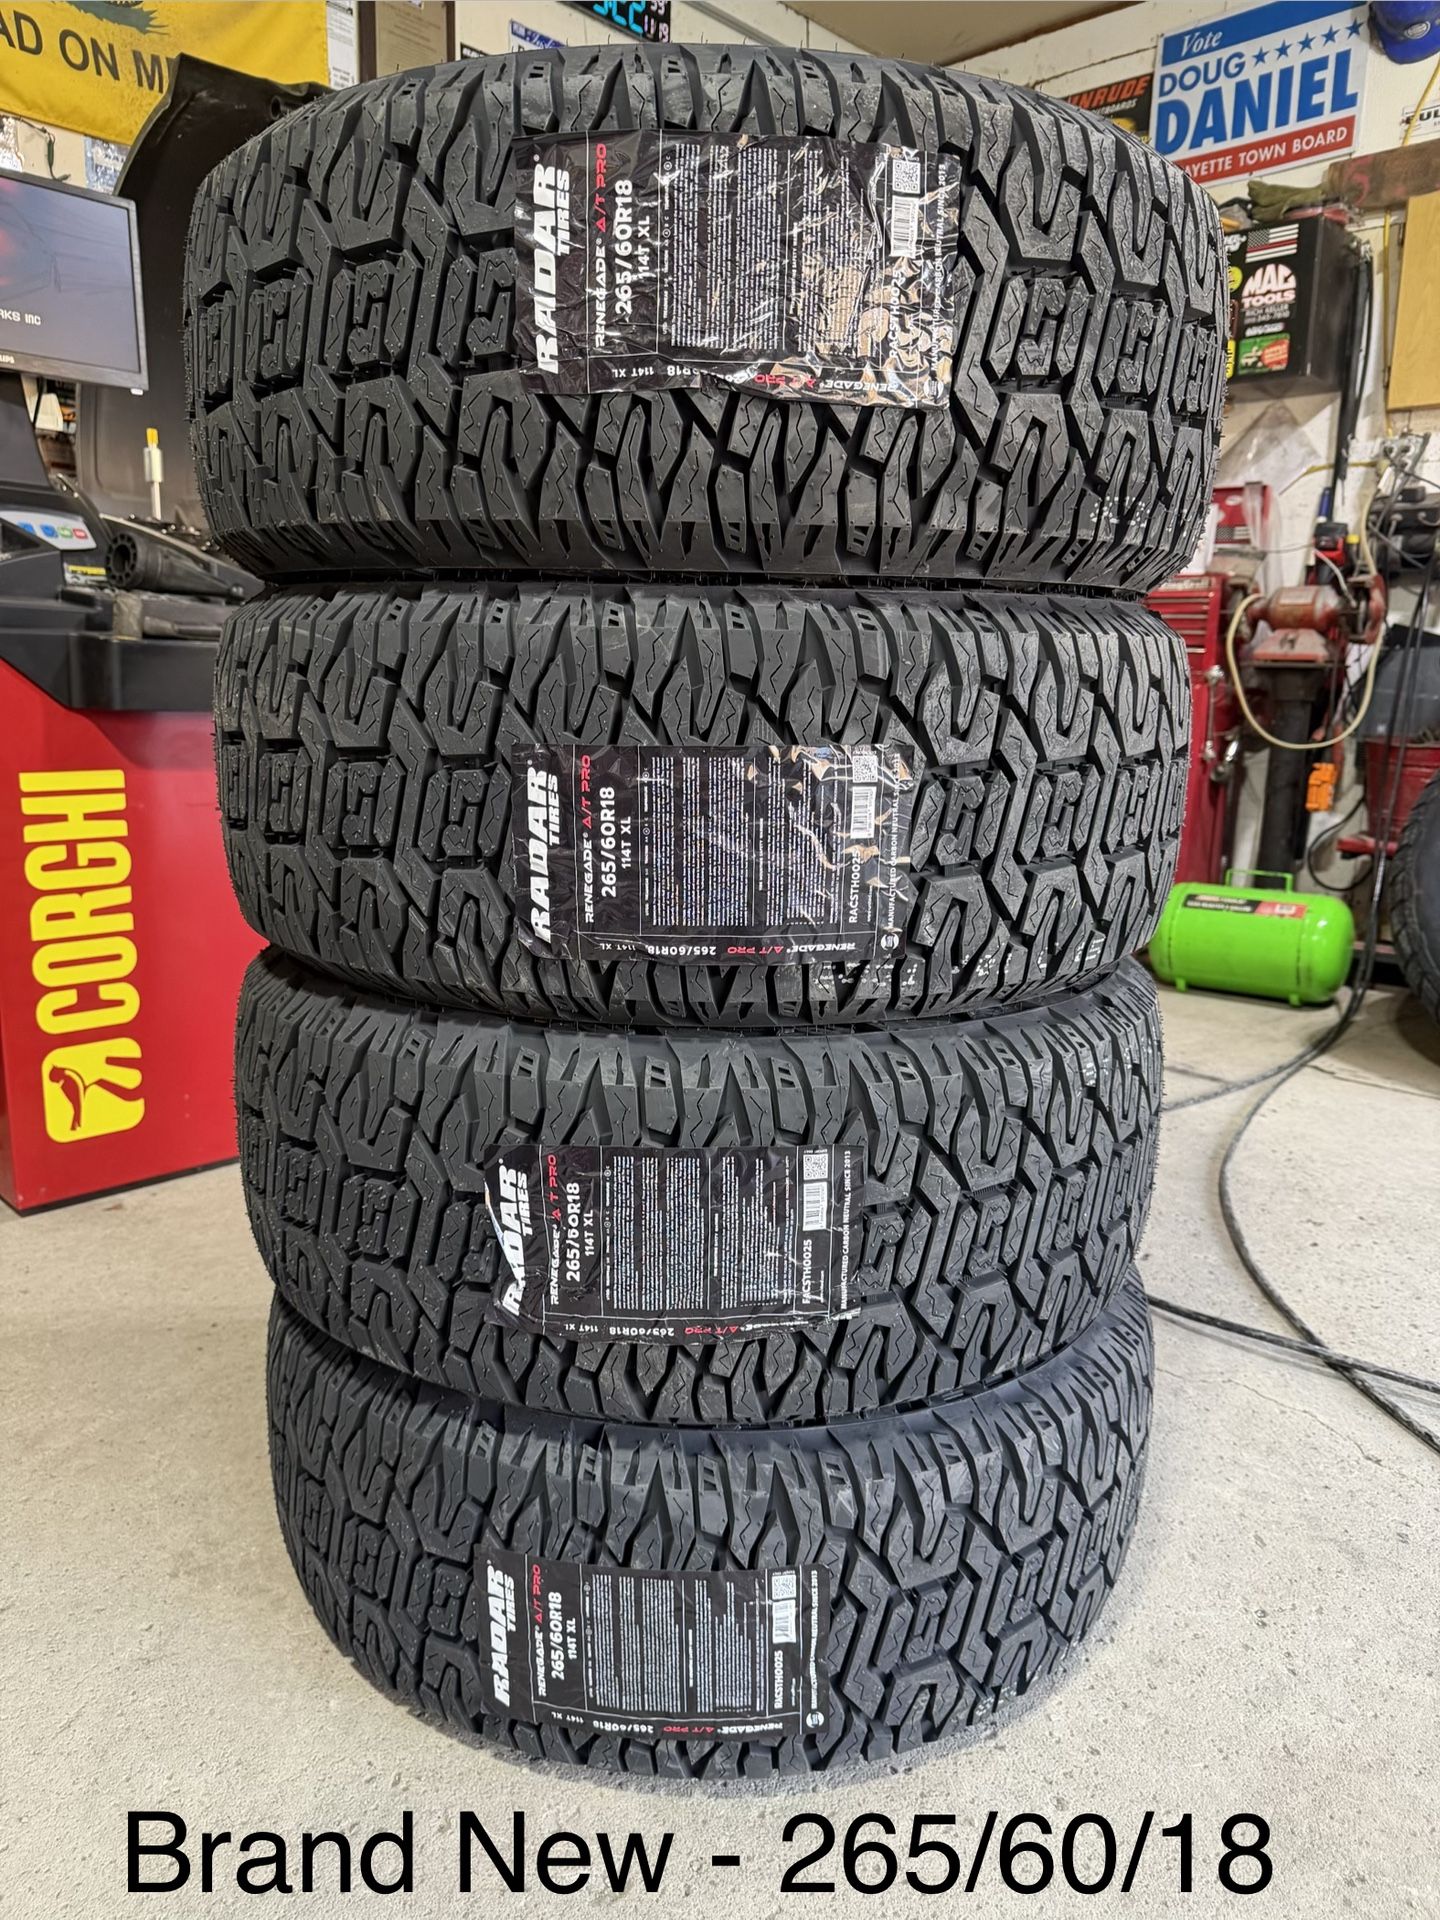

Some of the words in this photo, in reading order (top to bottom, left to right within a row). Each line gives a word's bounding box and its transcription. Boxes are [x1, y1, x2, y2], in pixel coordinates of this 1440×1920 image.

[59, 29, 120, 81] ON
[1181, 31, 1223, 57] Vote
[1159, 51, 1246, 98] DOUG
[1155, 48, 1359, 156] DANIEL
[1238, 141, 1287, 168] TOWN
[1292, 126, 1349, 156] BOARD
[595, 143, 607, 189] PRO
[557, 169, 570, 256] TIRES
[596, 193, 607, 232] A/T
[638, 216, 649, 237] XL
[614, 180, 633, 314] 265/60R18
[533, 163, 559, 374] RADAR
[1242, 263, 1297, 296] MAC
[1243, 289, 1296, 309] TOOLS
[611, 367, 626, 377] XL
[631, 366, 654, 377] 114T
[581, 755, 592, 793] PRO
[548, 774, 560, 846] TIRES
[581, 797, 592, 829] A/T
[622, 816, 631, 835] XL
[892, 797, 900, 833] NEUTRAL
[527, 766, 551, 943] RADAR
[600, 787, 616, 897] 265/60R18
[622, 840, 632, 869] 114T
[19, 769, 140, 1035] CORGHI
[848, 851, 861, 923] RACSTH0025
[727, 946, 755, 954] PRO
[548, 1154, 558, 1188] PRO
[517, 1171, 532, 1237] TIRES
[584, 1210, 593, 1226] XL
[585, 1231, 594, 1256] 114T
[842, 1225, 850, 1254] CARBON
[579, 1324, 598, 1332] 114T
[532, 1564, 541, 1595] PRO
[505, 1574, 516, 1632] TIRES
[487, 1565, 510, 1707] RADAR
[549, 1592, 565, 1680] 265/60R18
[567, 1618, 576, 1633] XL
[568, 1637, 577, 1660] 114T
